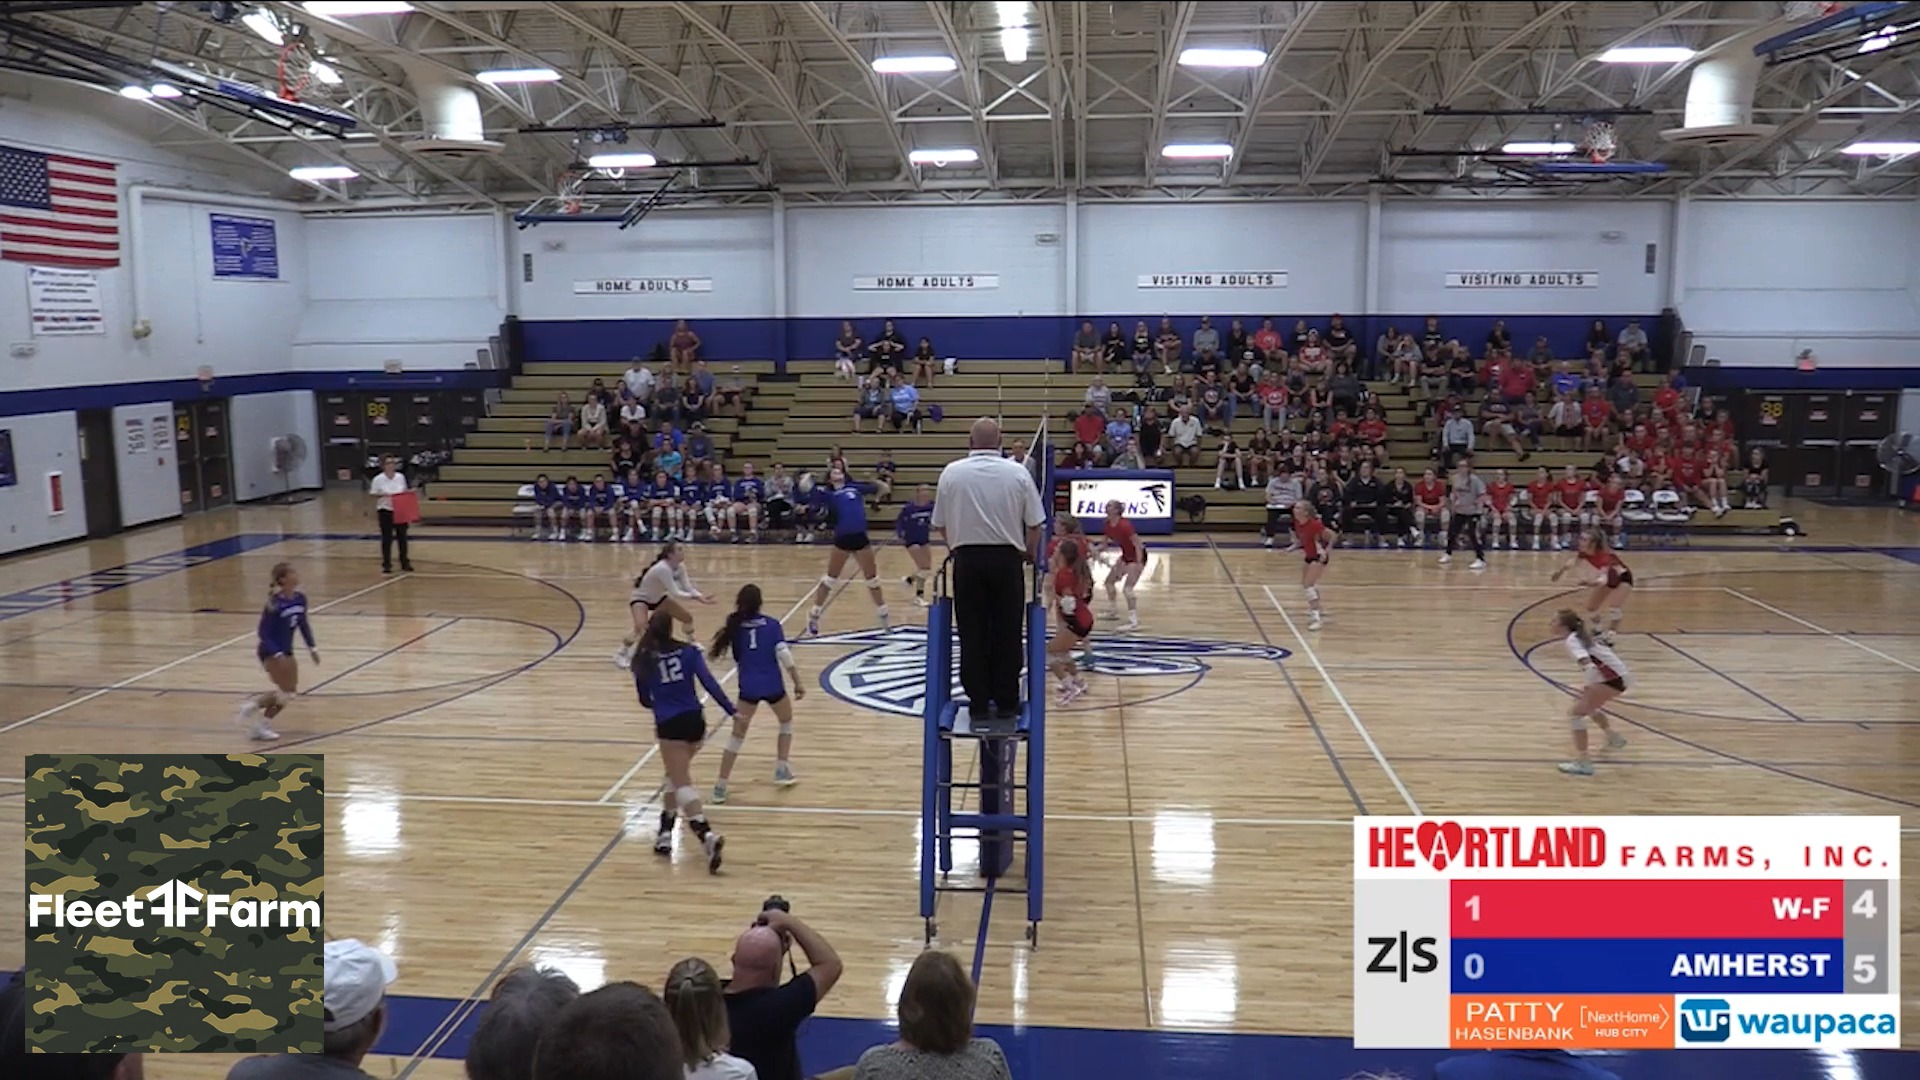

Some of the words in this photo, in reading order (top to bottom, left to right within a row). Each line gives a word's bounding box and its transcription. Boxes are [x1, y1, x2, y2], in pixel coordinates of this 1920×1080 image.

[877, 277, 915, 287] HOME
[922, 277, 974, 287] ADULTS
[1152, 275, 1212, 285] VISITING
[1220, 275, 1273, 285] ADULTS
[1460, 274, 1521, 285] VISITING
[1529, 274, 1584, 285] ADULTS
[597, 281, 632, 291] HOME
[639, 280, 689, 291] ADULTS
[1077, 500, 1148, 515] FALNS
[748, 627, 758, 650] 1
[658, 656, 684, 683] 12
